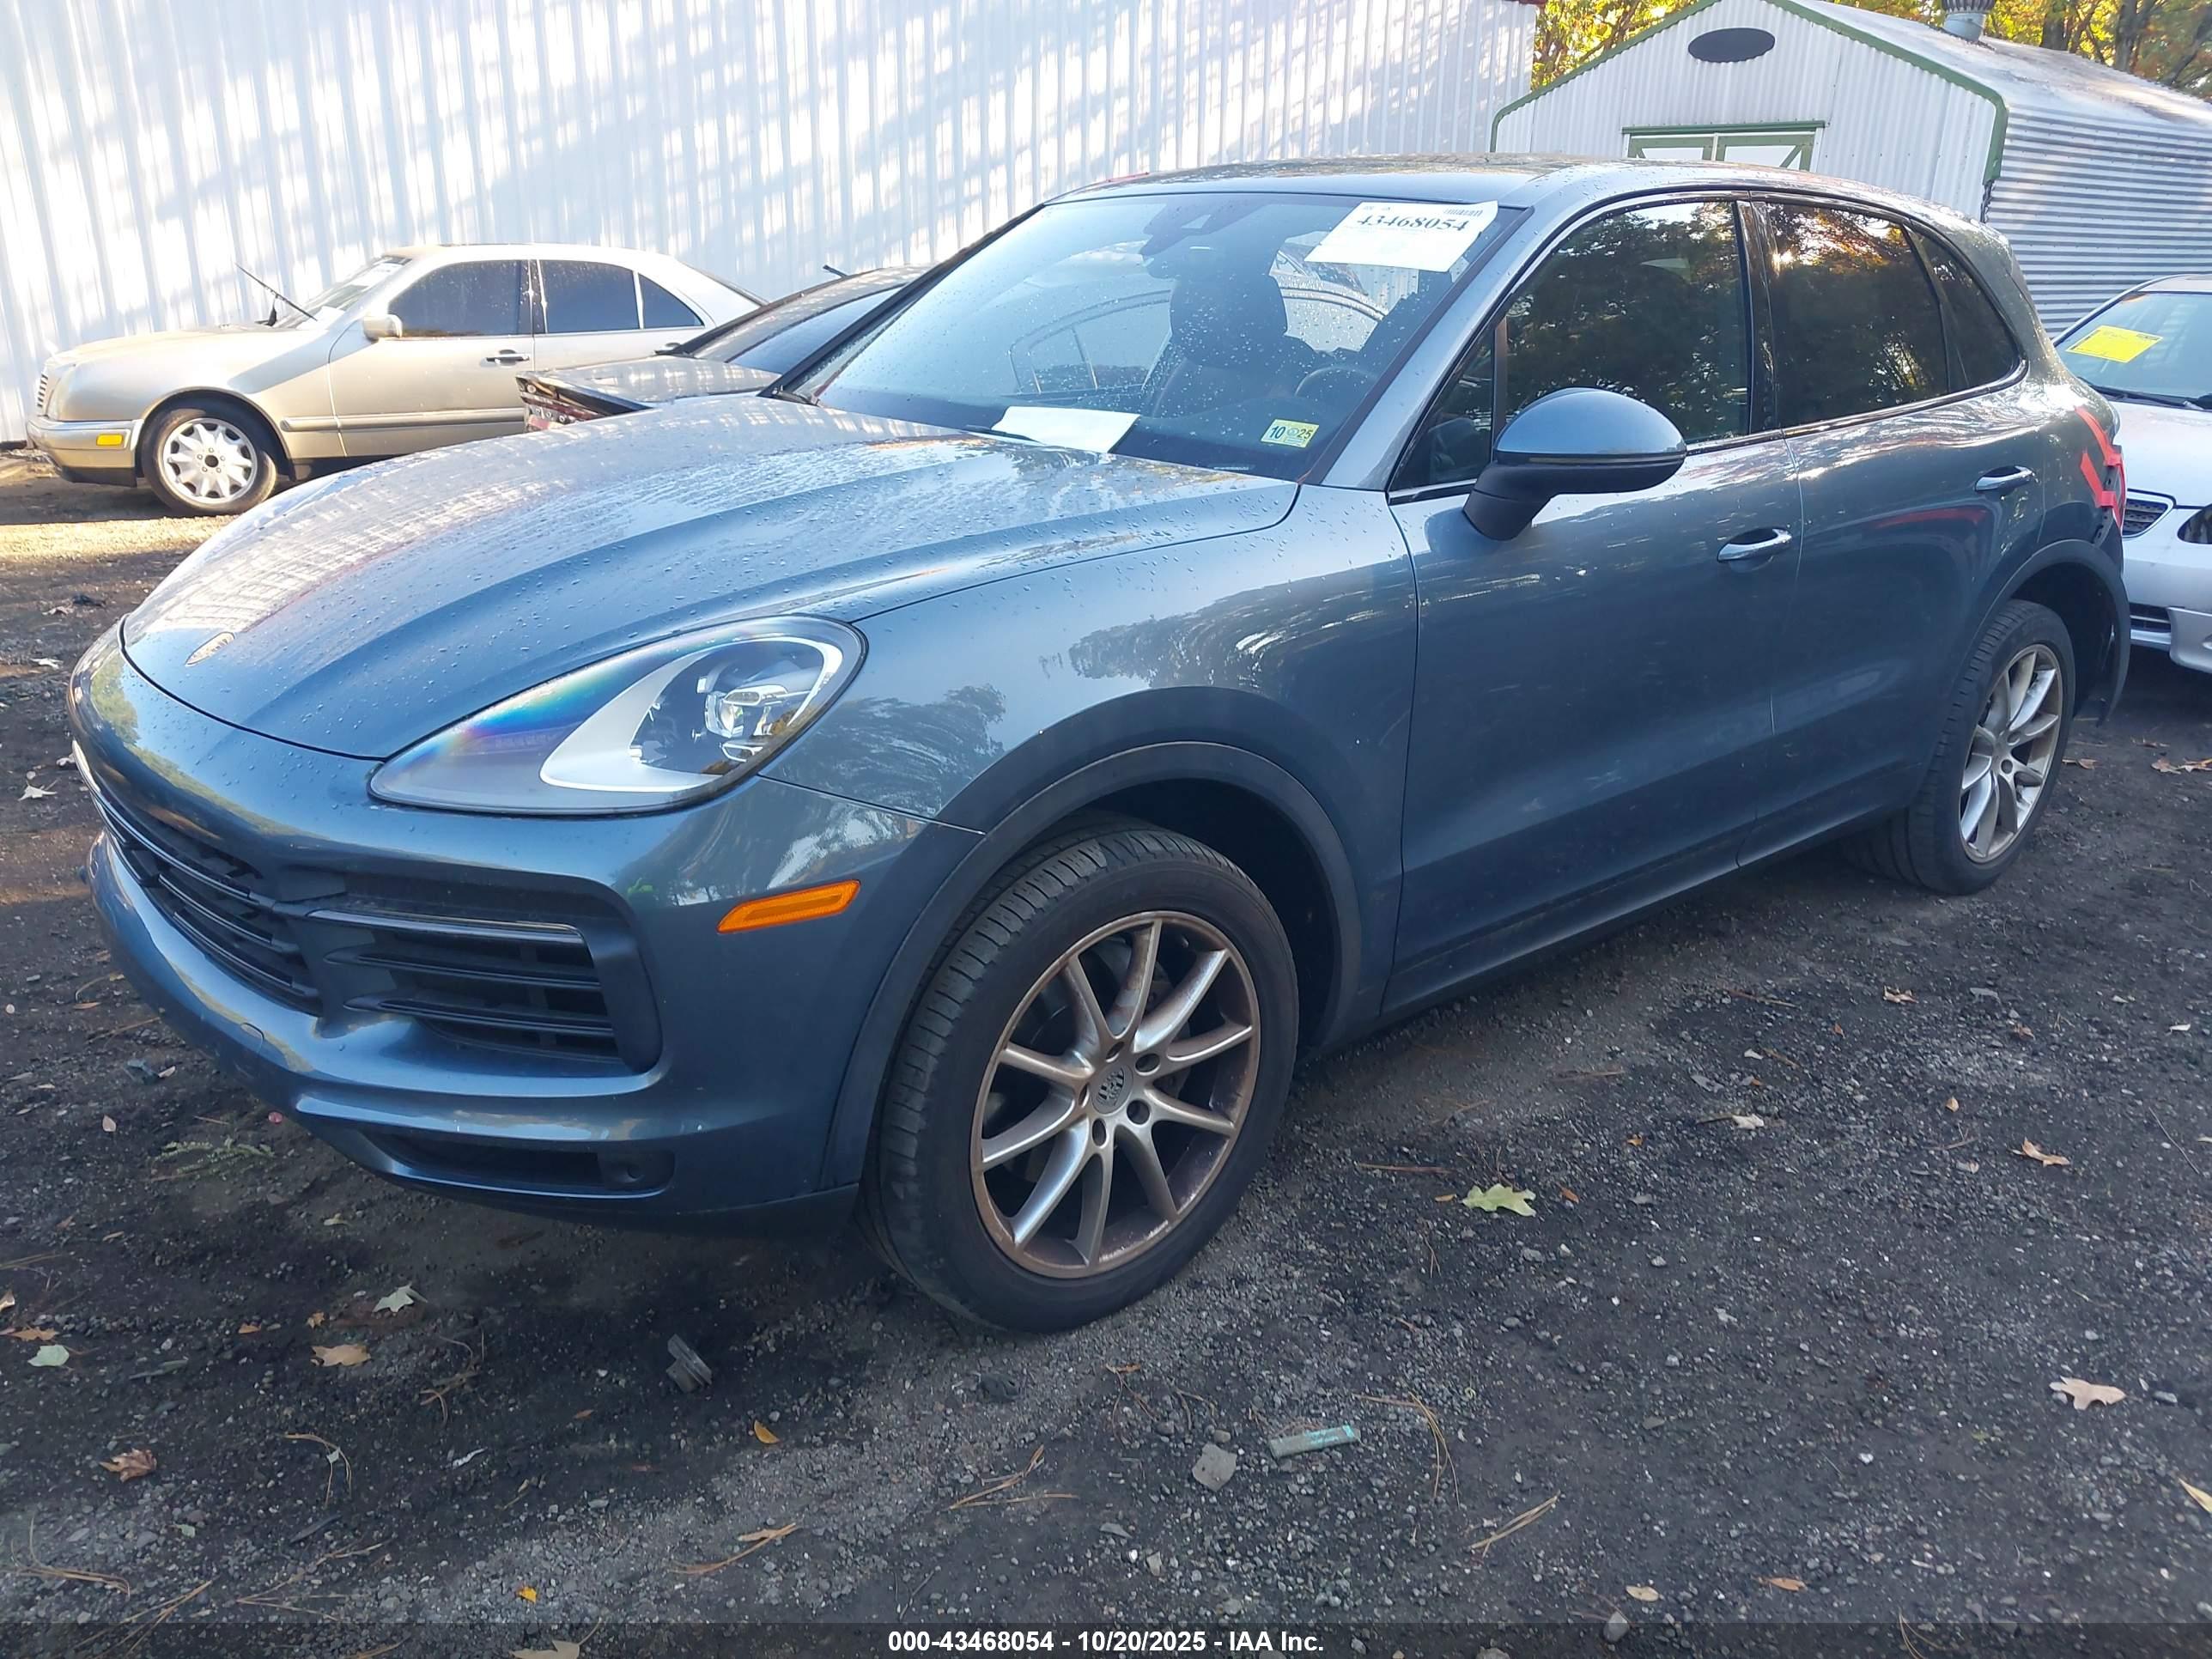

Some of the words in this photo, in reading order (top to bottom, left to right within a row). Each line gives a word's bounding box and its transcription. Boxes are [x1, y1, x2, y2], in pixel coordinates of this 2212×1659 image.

[1357, 214, 1469, 231] 43468054
[1270, 426, 1286, 439] 10
[1297, 428, 1314, 440] 25
